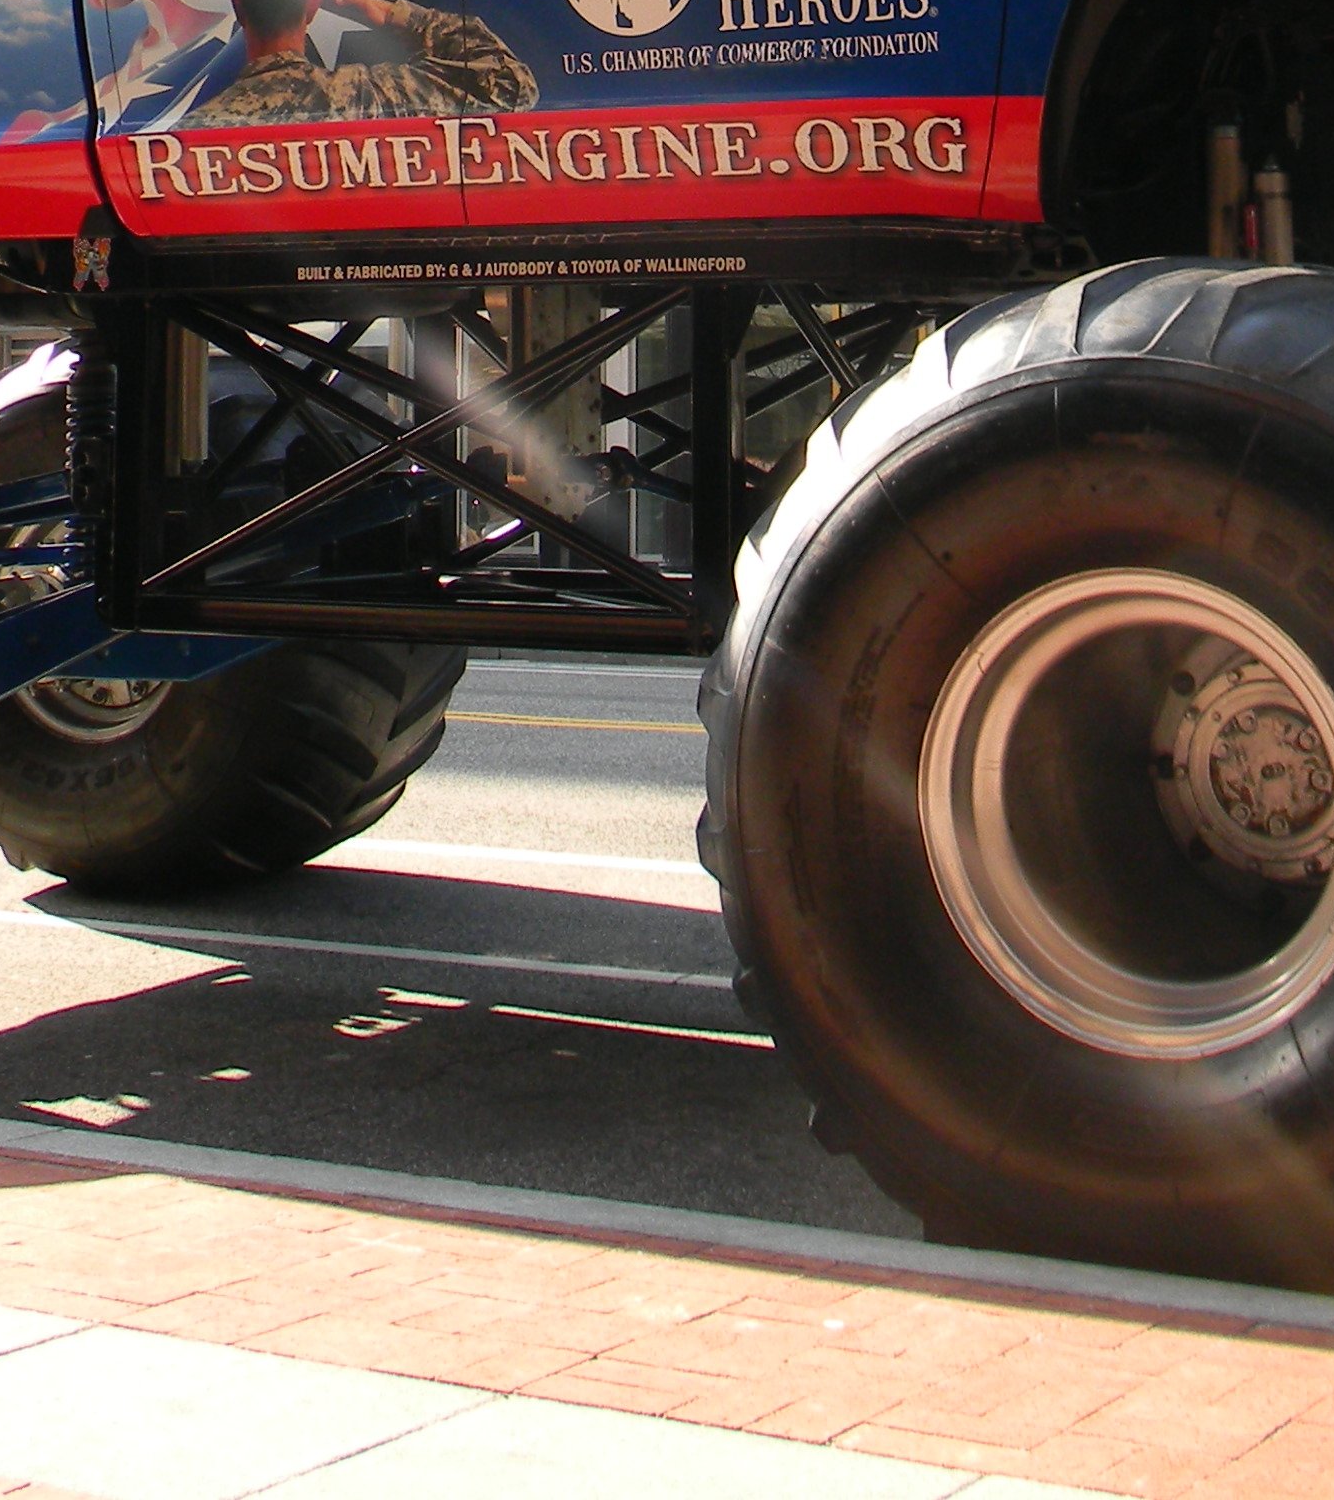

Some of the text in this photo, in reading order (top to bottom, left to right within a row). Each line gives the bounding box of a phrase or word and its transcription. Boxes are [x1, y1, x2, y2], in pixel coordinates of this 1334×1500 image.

[562, 32, 939, 74] U.S. CHAMBER OF COMMERCE FOUNDATION
[129, 117, 966, 199] RESUMEENGINE.ORG
[297, 257, 747, 281] BUILT & FABRICATED BY: G & J AUTOBODY & TOYOTA OF WALLINGFORD
